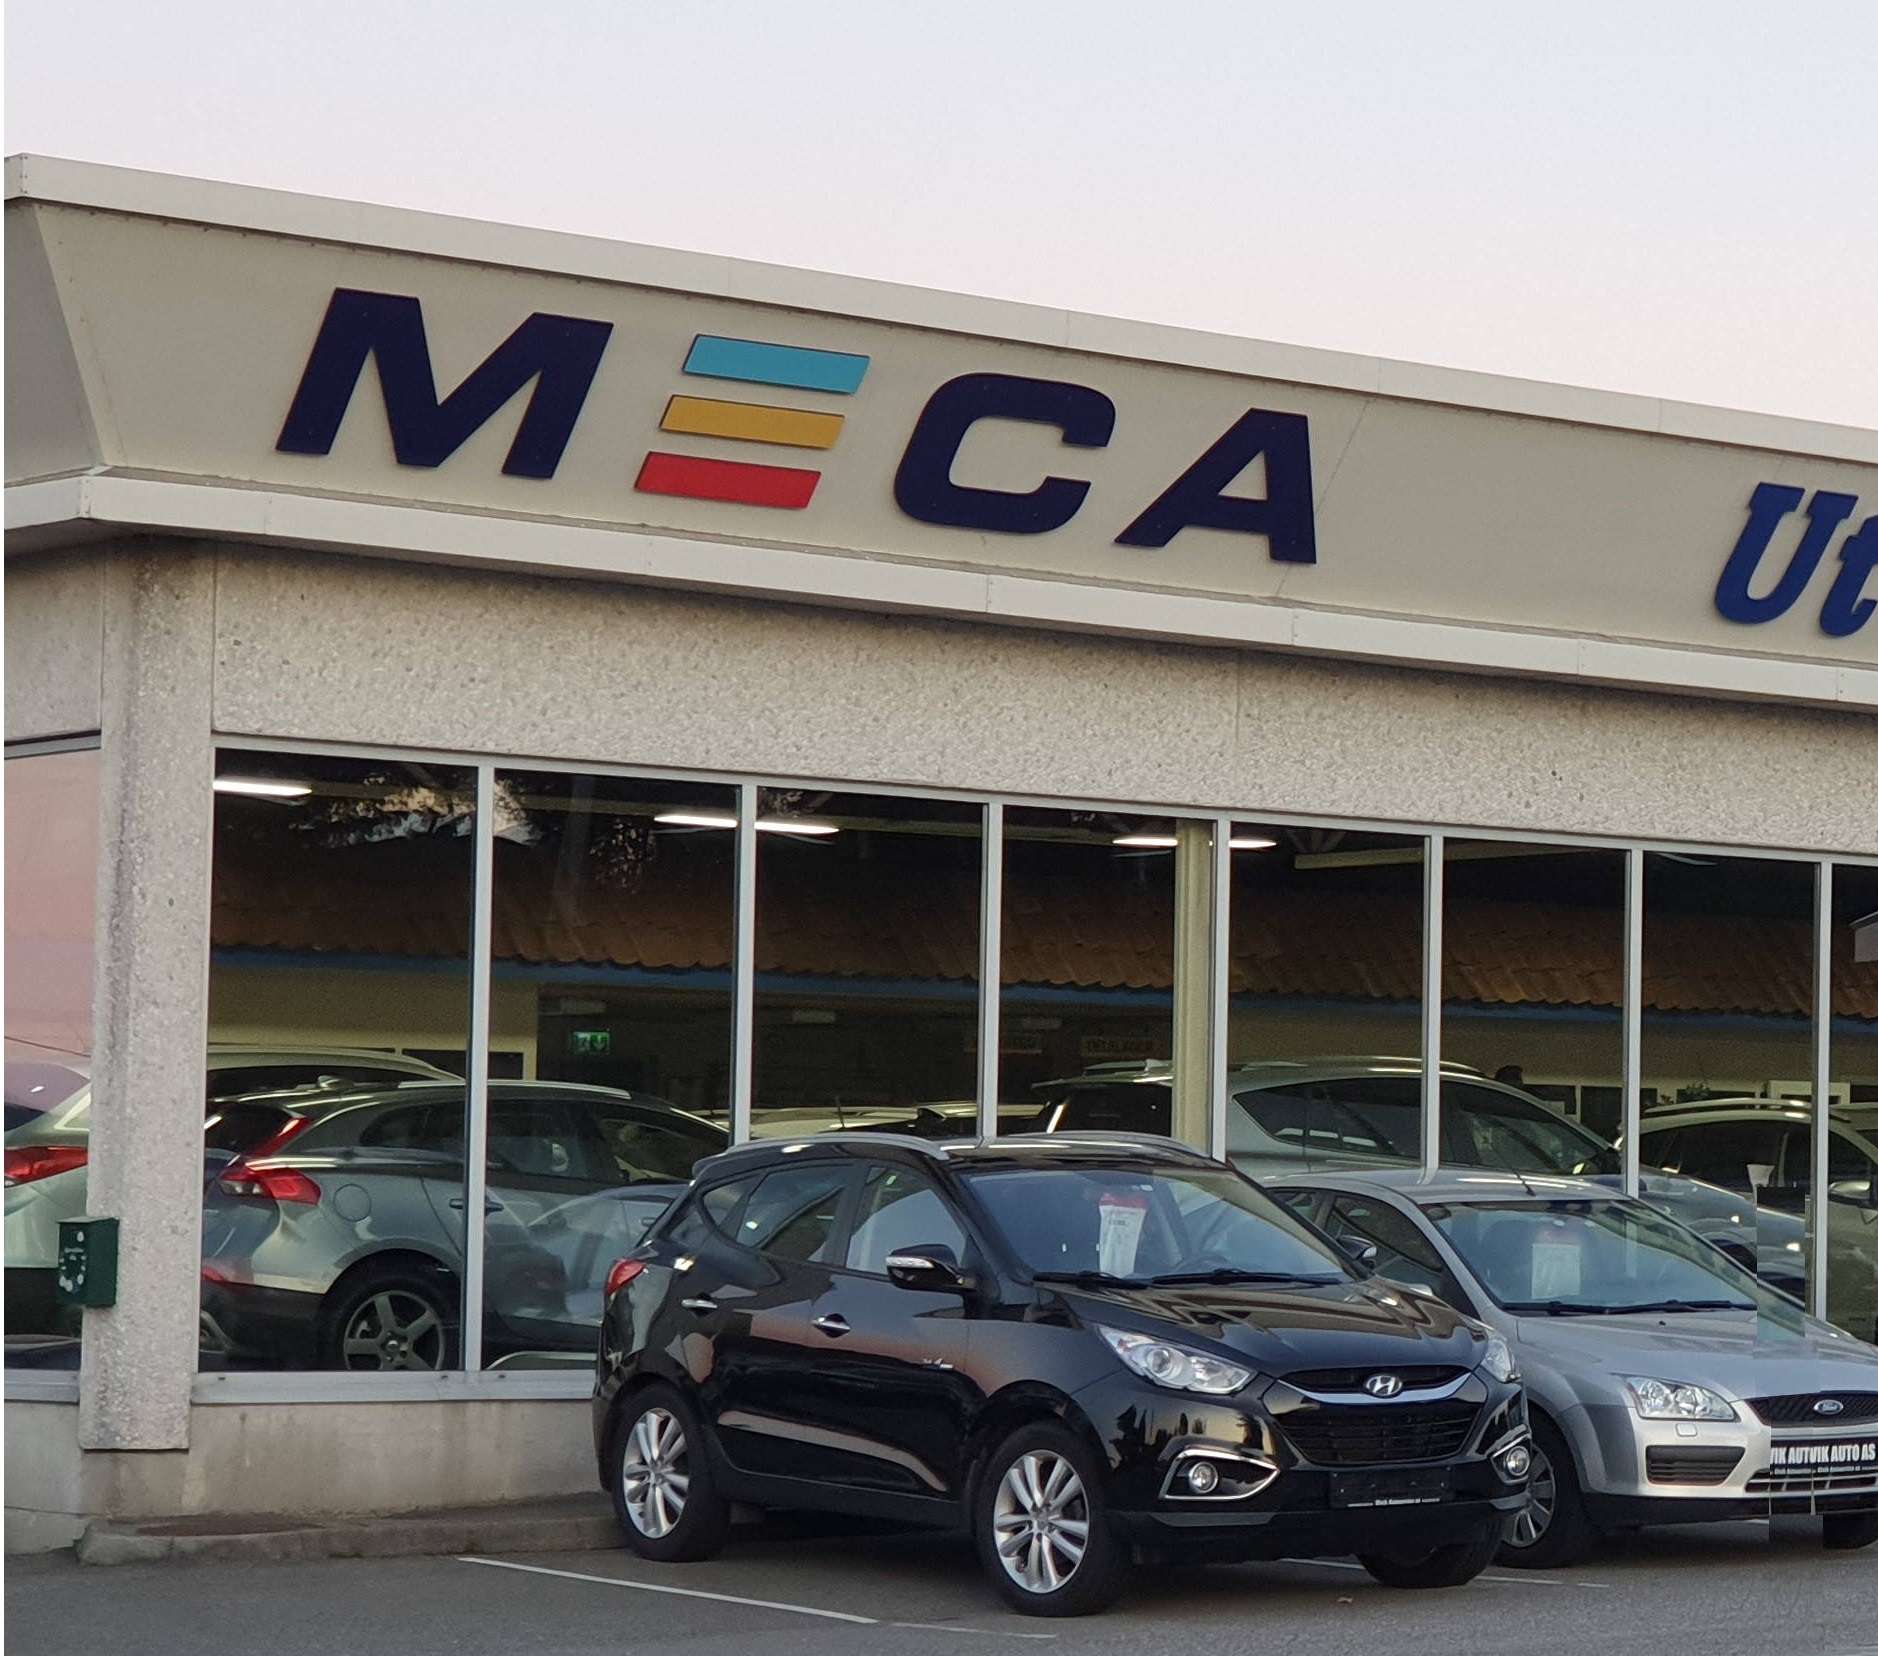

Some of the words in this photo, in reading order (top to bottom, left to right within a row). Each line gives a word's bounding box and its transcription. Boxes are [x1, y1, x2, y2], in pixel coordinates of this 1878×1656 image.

[276, 286, 1316, 564] MECA
[1831, 1443, 1860, 1462] AUTO
[1861, 1442, 1876, 1461] AS
